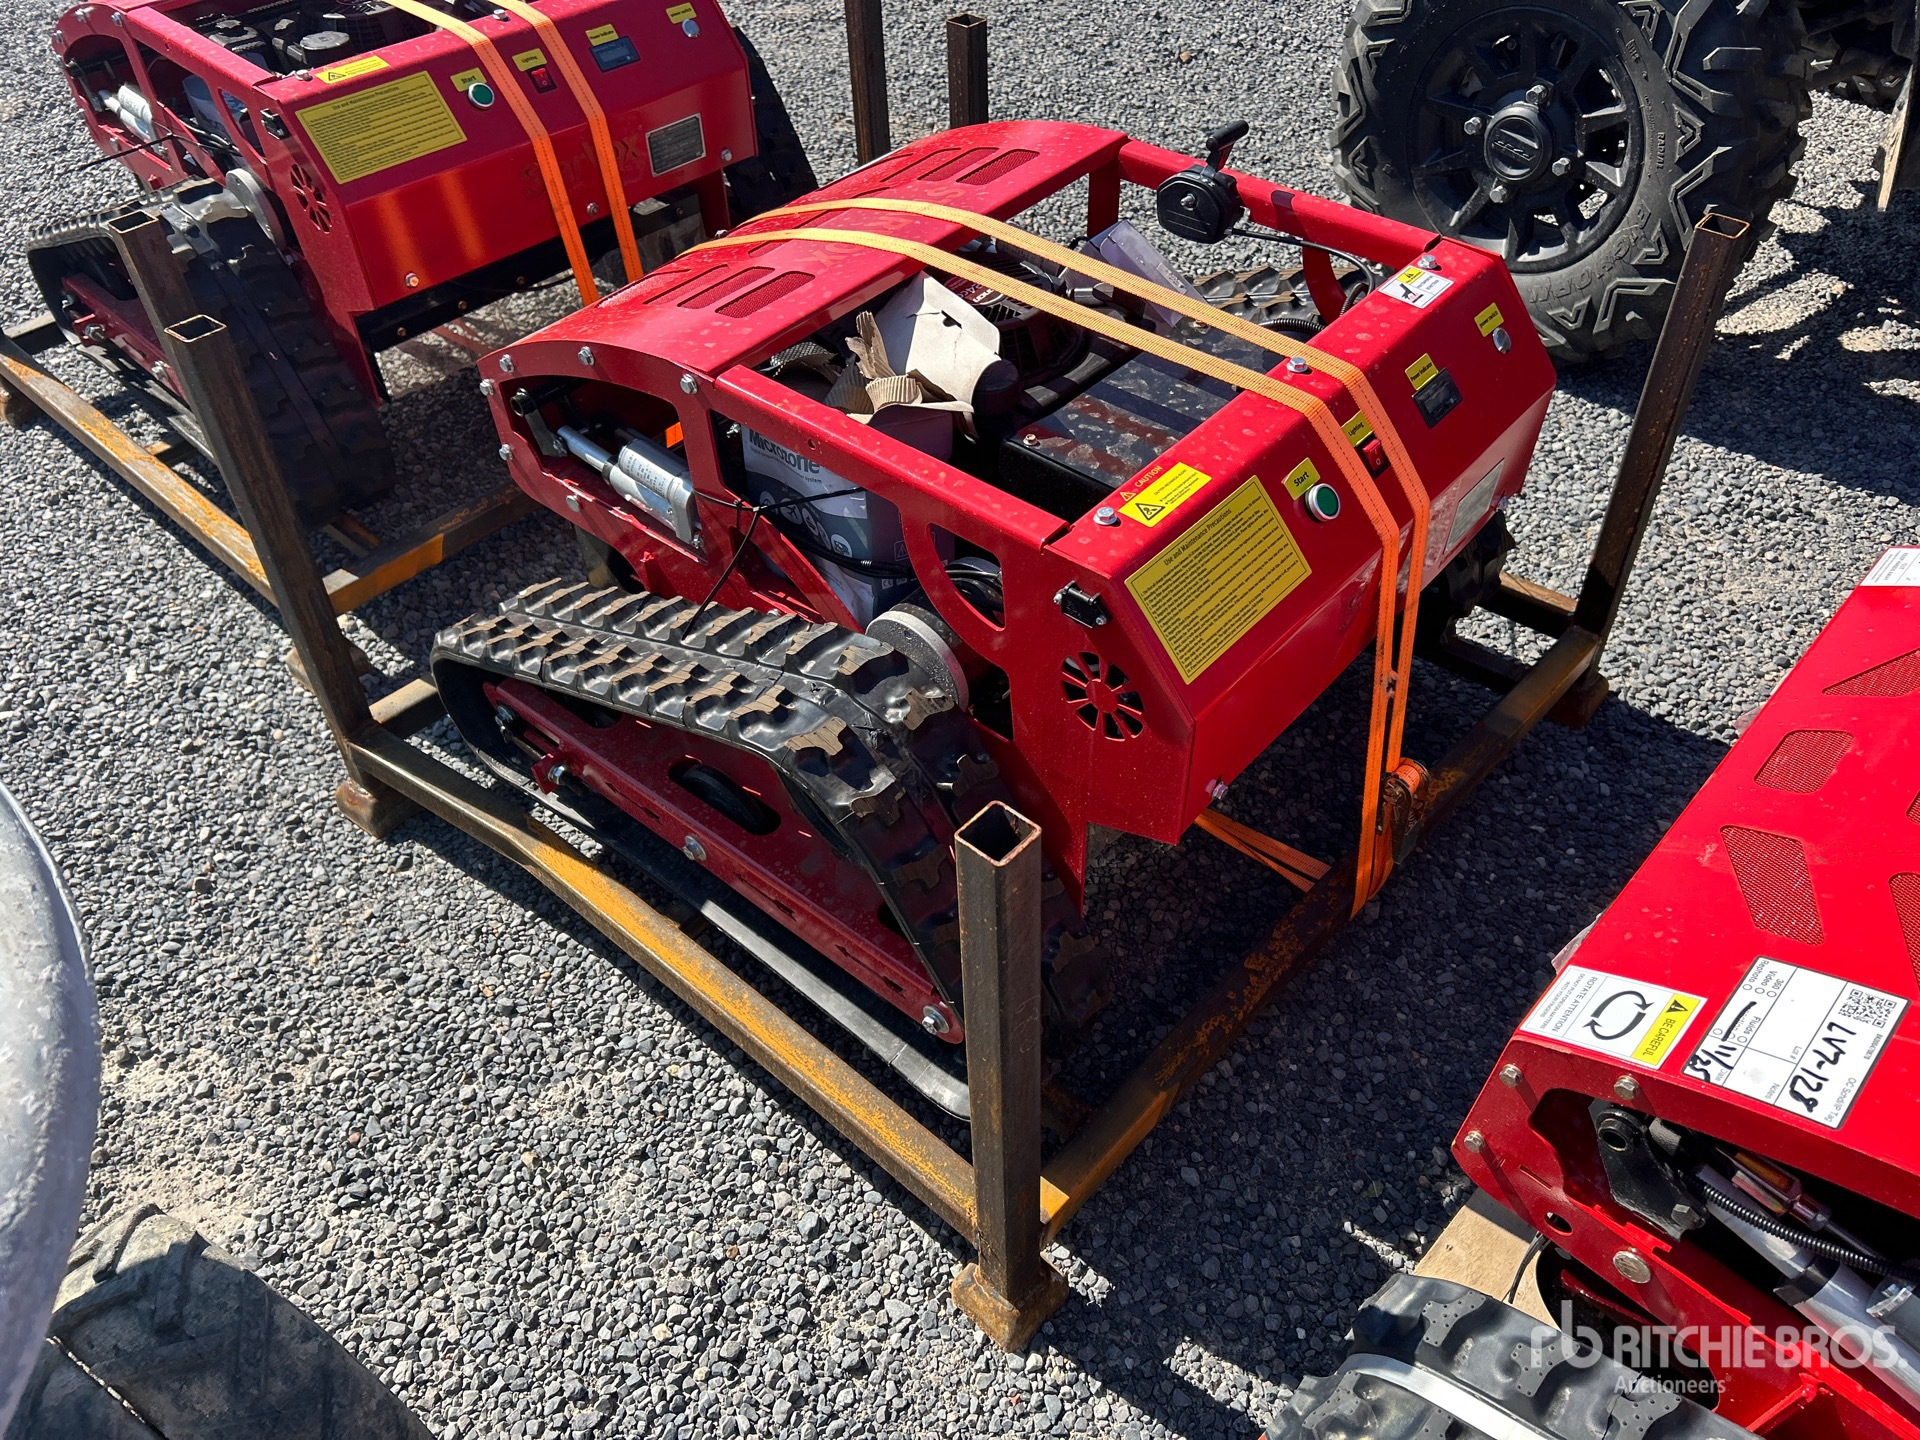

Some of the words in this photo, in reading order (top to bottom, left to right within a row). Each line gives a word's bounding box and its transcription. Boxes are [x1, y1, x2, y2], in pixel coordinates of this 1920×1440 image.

[461, 75, 476, 84] Start
[1348, 422, 1364, 436] Lighting
[1135, 465, 1163, 488] CAUTION
[1293, 471, 1309, 487] Start
[1164, 555, 1174, 566] Use
[1172, 548, 1182, 559] and
[1180, 526, 1208, 552] Maintenance
[1206, 507, 1231, 531] Precautions
[1748, 960, 1769, 983] Rephoto
[1761, 970, 1777, 986] Video
[1578, 976, 1598, 1000] ROTATE
[1773, 979, 1784, 990] 360
[1551, 999, 1582, 1032] ATTENTION
[1664, 1018, 1676, 1029] BE
[1743, 1016, 1761, 1035] Fluids
[1642, 1028, 1670, 1056] CAREFUL
[1764, 1083, 1780, 1100] Notes
[1824, 1109, 1838, 1122] Tag
